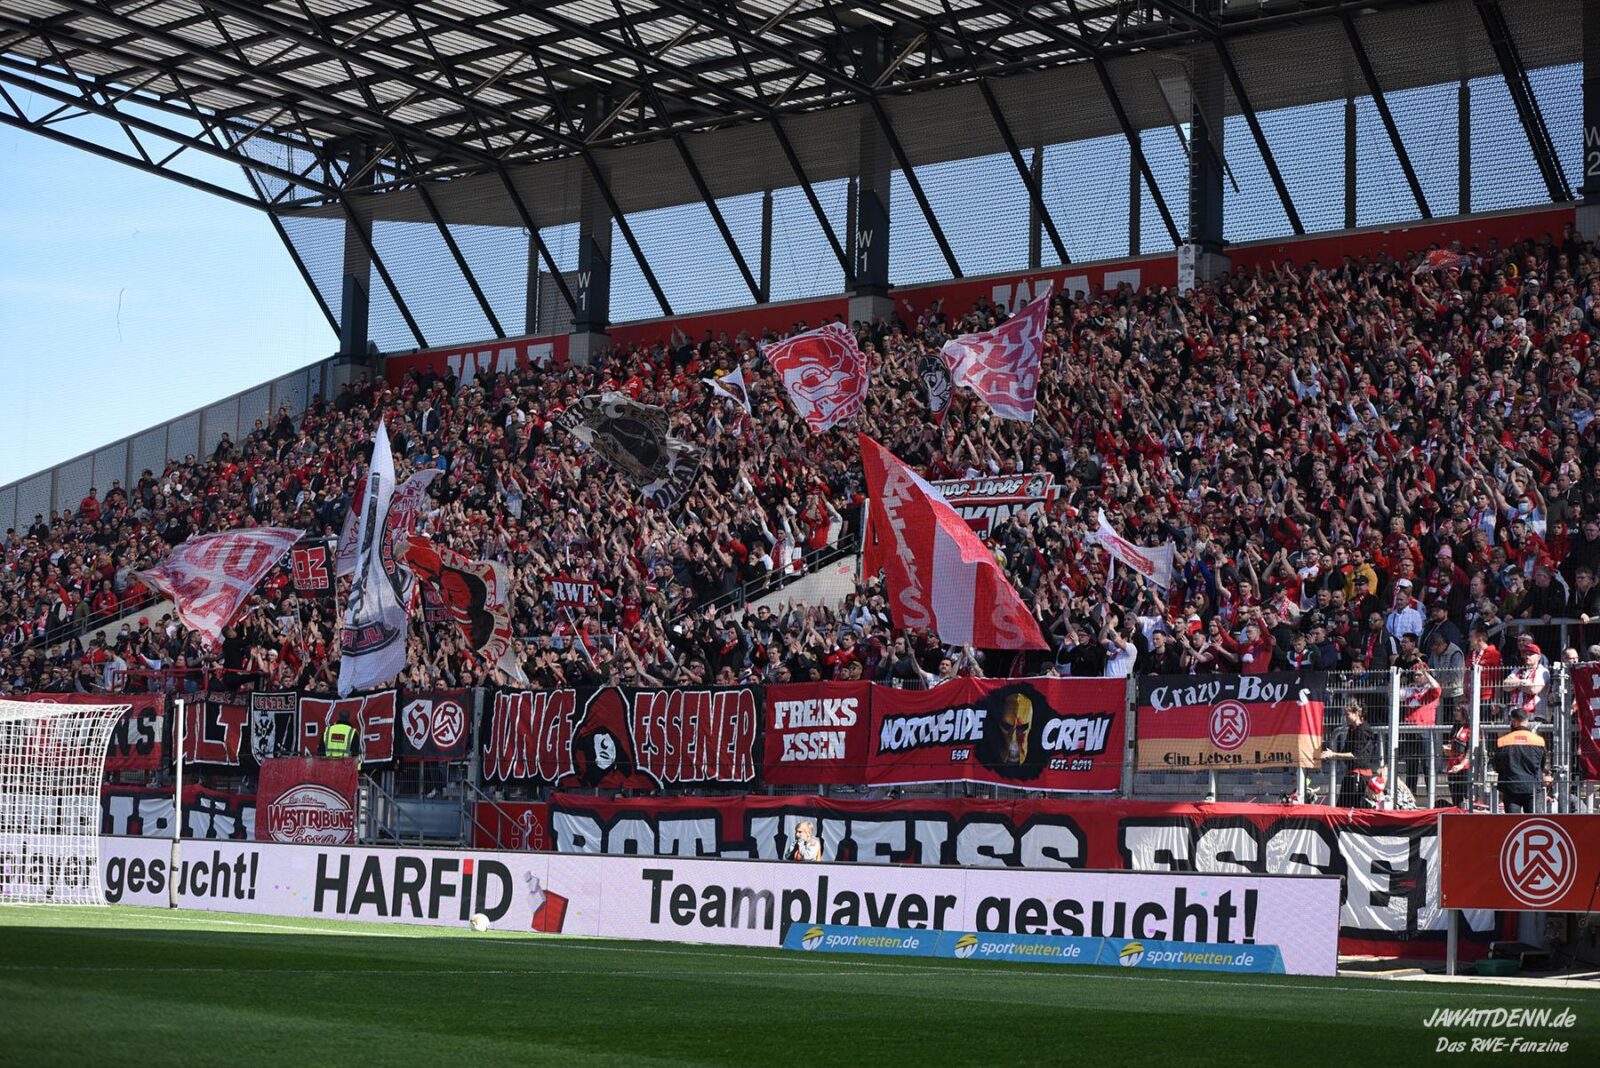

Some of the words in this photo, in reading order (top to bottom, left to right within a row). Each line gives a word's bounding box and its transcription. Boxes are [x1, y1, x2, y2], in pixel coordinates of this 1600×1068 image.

[857, 229, 873, 247] W
[861, 253, 868, 273] 1
[578, 271, 591, 288] W
[580, 292, 587, 311] 1
[552, 581, 596, 607] RWE
[774, 697, 859, 729] FREAKS
[483, 689, 577, 782] JUNGE
[634, 689, 756, 783] ESSENER
[880, 708, 988, 752] NORTHSIDE
[1041, 717, 1110, 752] CREW
[781, 731, 847, 762] ESSEN
[1050, 759, 1069, 770] EST.
[1071, 759, 1093, 771] 2011
[105, 851, 259, 903] gesucht!
[642, 868, 957, 946] Teamplayer
[976, 887, 1258, 944] gesucht!
[825, 931, 920, 951] sportwetten.de
[980, 940, 1081, 958] sportwetten.de
[1146, 949, 1254, 967] sportwetten.de
